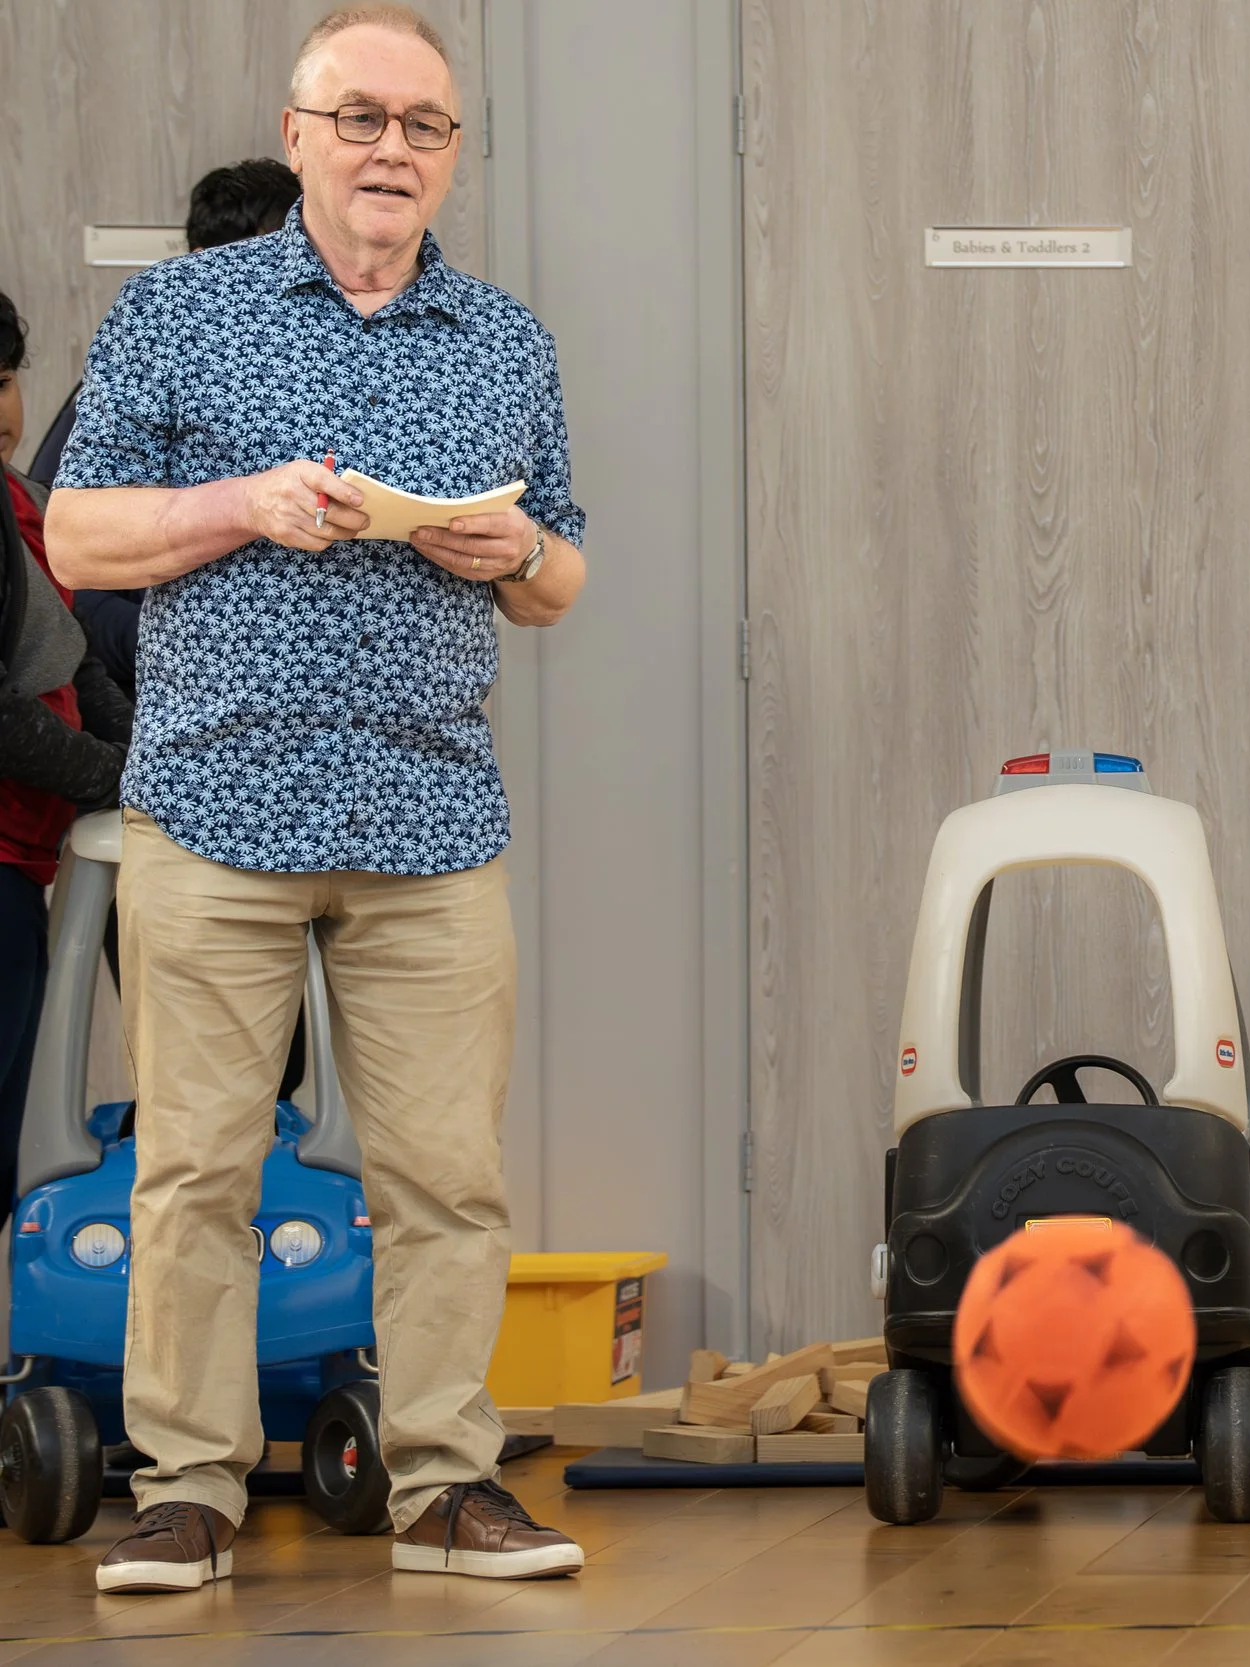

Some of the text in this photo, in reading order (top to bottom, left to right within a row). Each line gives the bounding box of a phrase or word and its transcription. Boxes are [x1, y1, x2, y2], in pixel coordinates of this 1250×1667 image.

[952, 239, 1091, 254] Babies & Toddlers 2
[992, 1156, 1140, 1219] COZY COUPE
